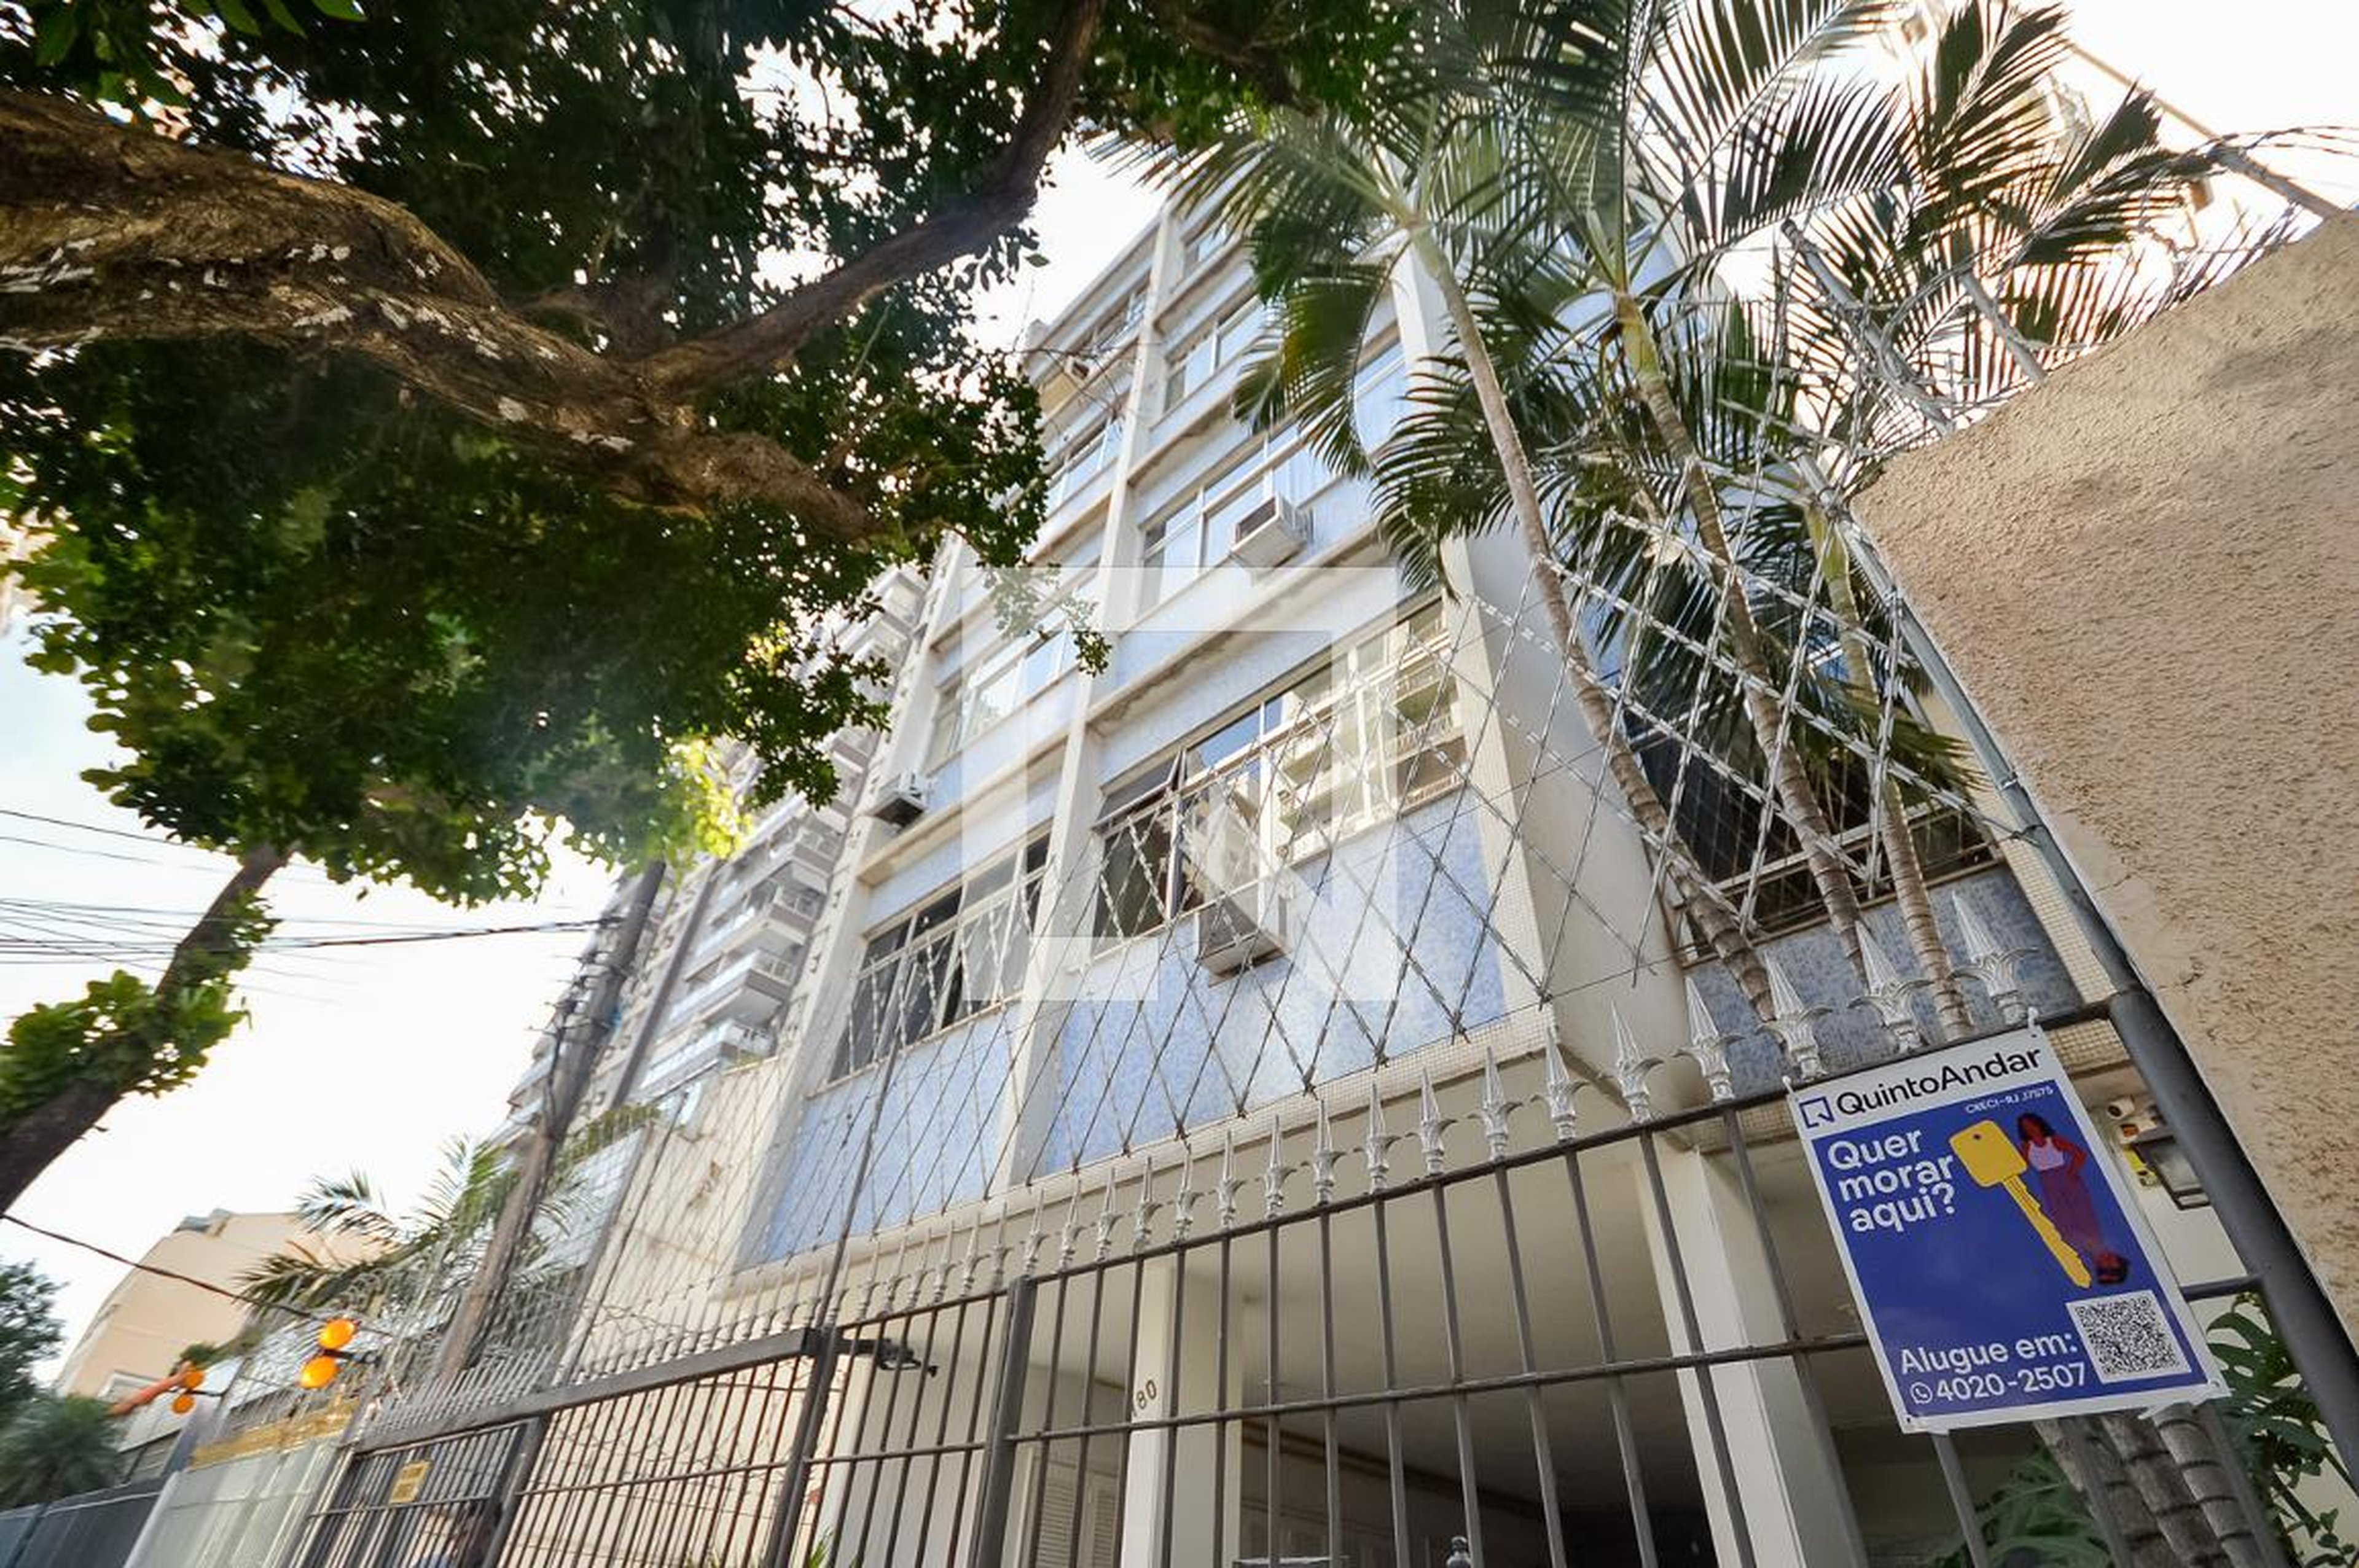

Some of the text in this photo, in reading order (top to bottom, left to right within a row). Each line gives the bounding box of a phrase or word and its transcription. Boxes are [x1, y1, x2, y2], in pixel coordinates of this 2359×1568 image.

[1836, 1048, 2041, 1115] QuintoAndar
[1828, 1130, 1922, 1170] Quer
[1838, 1155, 1954, 1202] morar
[1849, 1182, 1955, 1233] aqui?
[1901, 1333, 2078, 1375] Alugue em:
[1133, 1379, 1157, 1417] 80
[1936, 1362, 2086, 1402] 4020-2507
